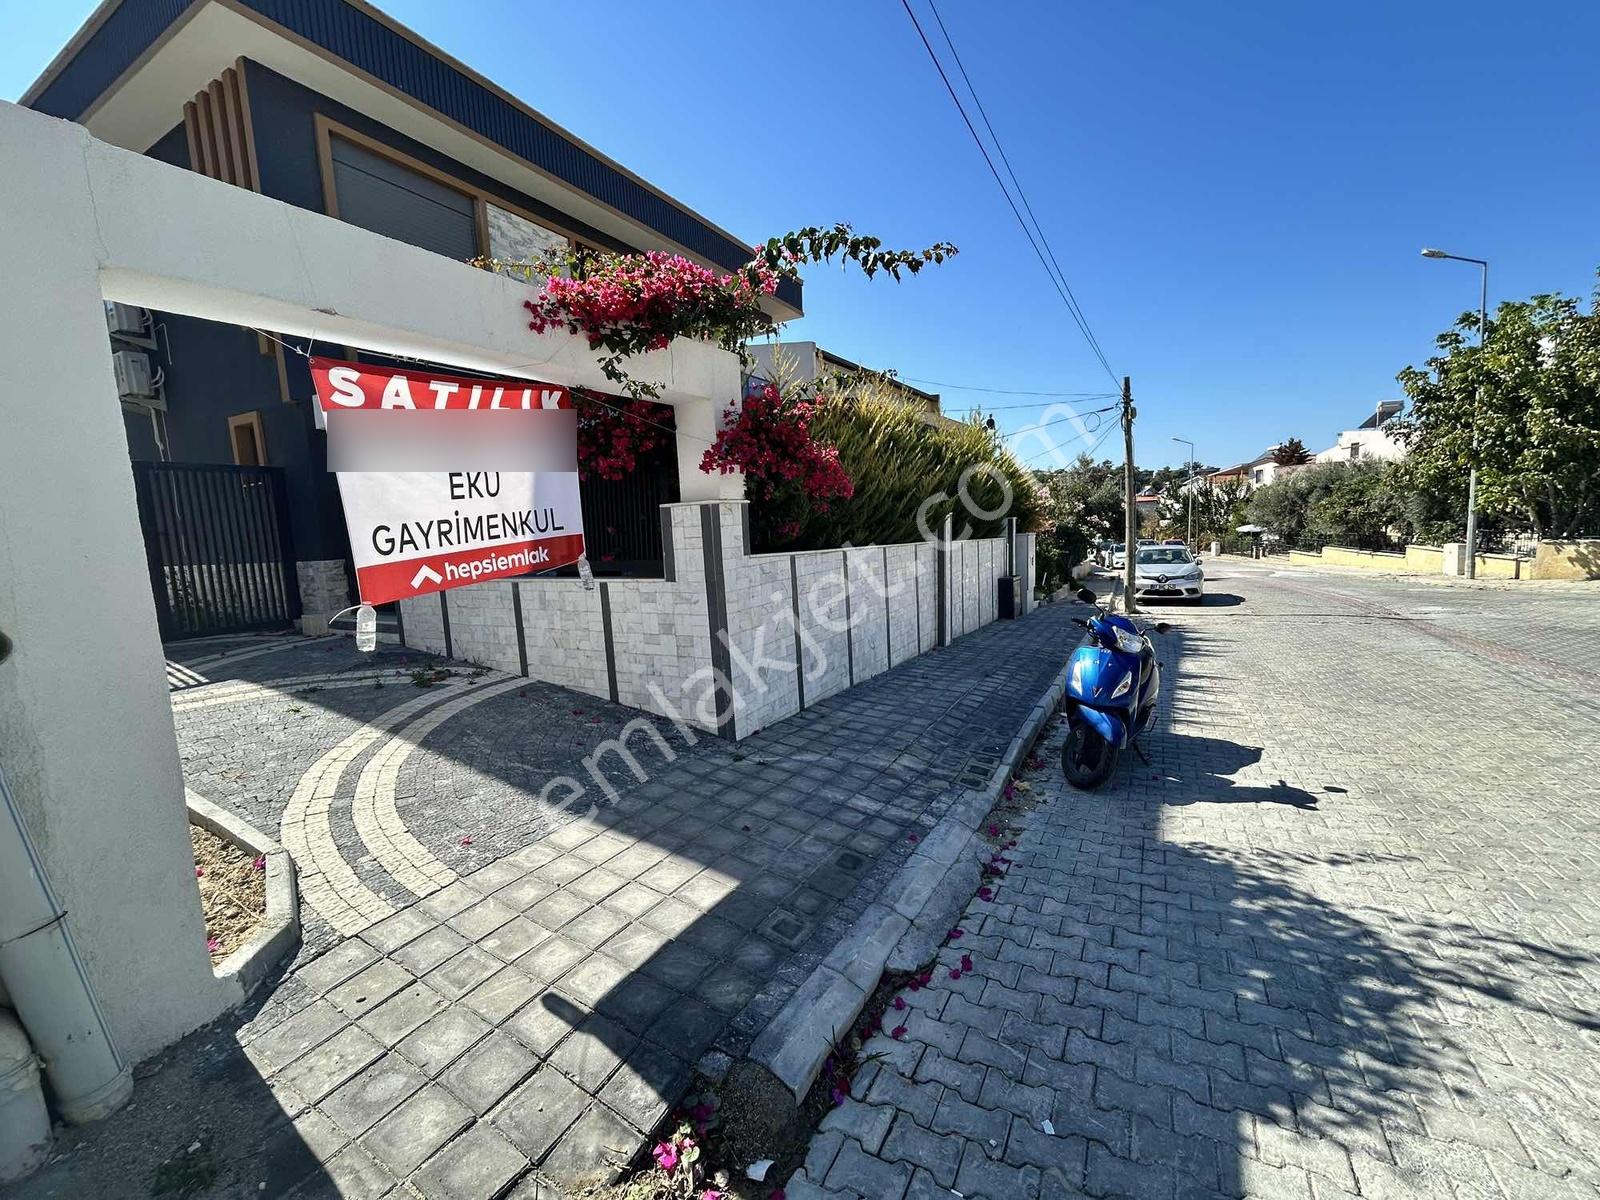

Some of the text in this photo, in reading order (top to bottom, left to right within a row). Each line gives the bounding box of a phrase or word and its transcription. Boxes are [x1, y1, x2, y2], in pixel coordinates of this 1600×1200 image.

[328, 366, 562, 409] SATILIK
[372, 507, 564, 556] GAYRİMENKUL
[445, 546, 549, 581] hepsiemlak
